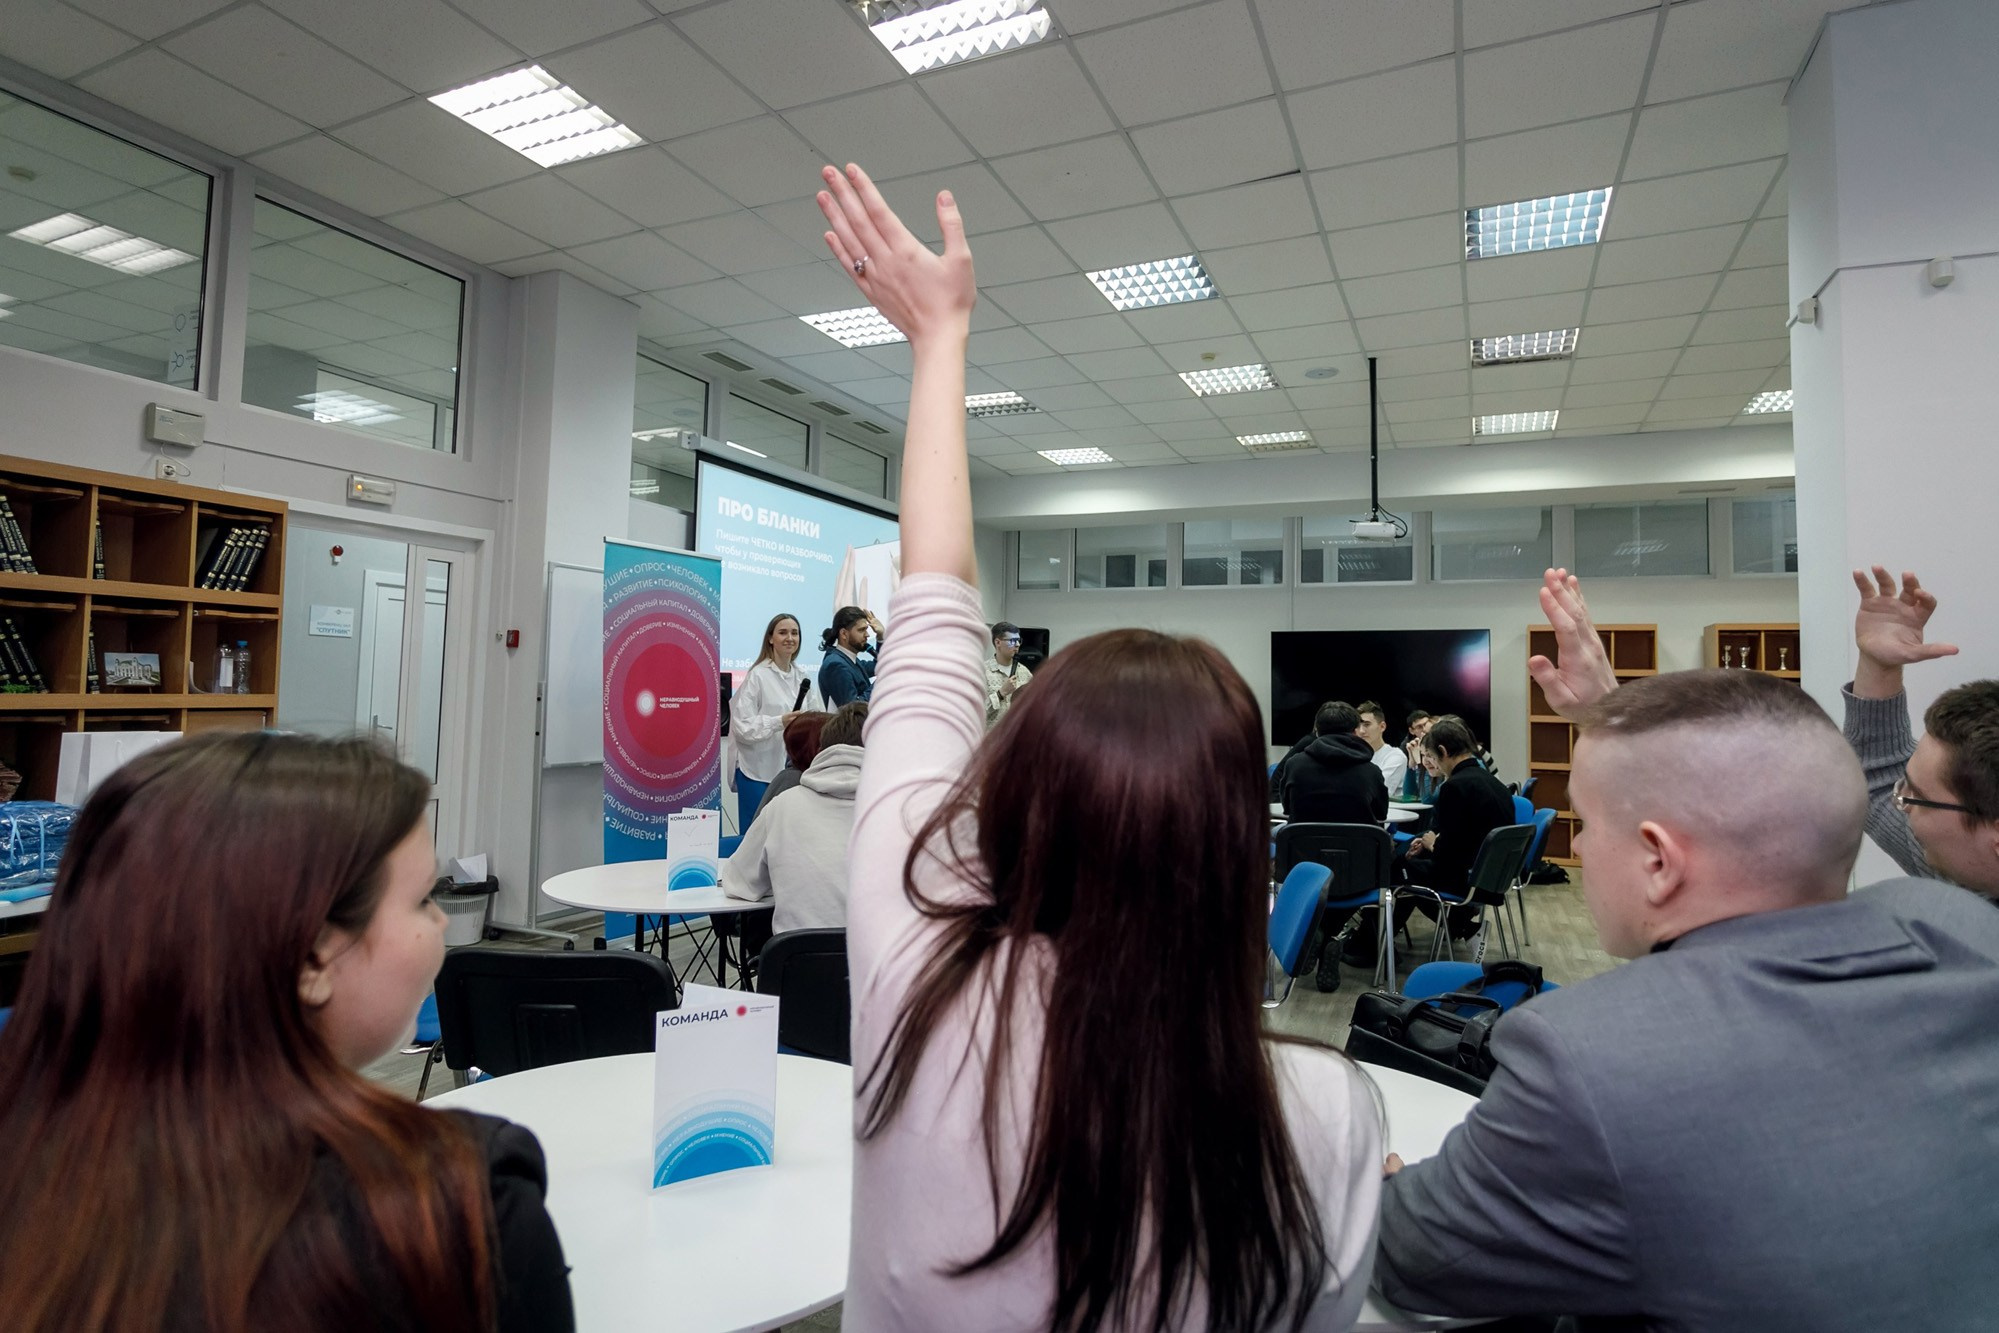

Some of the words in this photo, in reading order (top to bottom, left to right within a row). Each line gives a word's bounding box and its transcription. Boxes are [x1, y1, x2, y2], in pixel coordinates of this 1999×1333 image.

[718, 496, 754, 522] ПРО
[757, 507, 821, 539] БЛАНКИ
[714, 544, 740, 557] чтобы
[716, 529, 750, 545] Пишите
[751, 537, 778, 551] ЧЕТКО
[633, 562, 666, 574] ОПРОС
[671, 565, 709, 590] ЧЕЛОВЕК
[613, 579, 653, 602] РАЗВИТИЕ
[658, 579, 708, 605] ПСИХОЛОГИЯ
[613, 598, 658, 628] СОЦИАЛЬНЫЙ
[658, 599, 688, 612] КАПИТАЛ
[690, 609, 716, 637] ДОВЕРИЕ
[603, 655, 619, 706] СОЦИАЛЬНЫЙ
[617, 631, 638, 657] КАПИТАЛ
[602, 757, 650, 801] НЕРАВНОДУШИ
[654, 783, 699, 803] СОЦИОЛОГИЯ
[609, 818, 657, 841] РАЗВИТИЕ
[669, 814, 699, 822] КОМАНДА
[1475, 941, 1485, 964] crocs
[661, 1008, 729, 1028] КОМАНДА
